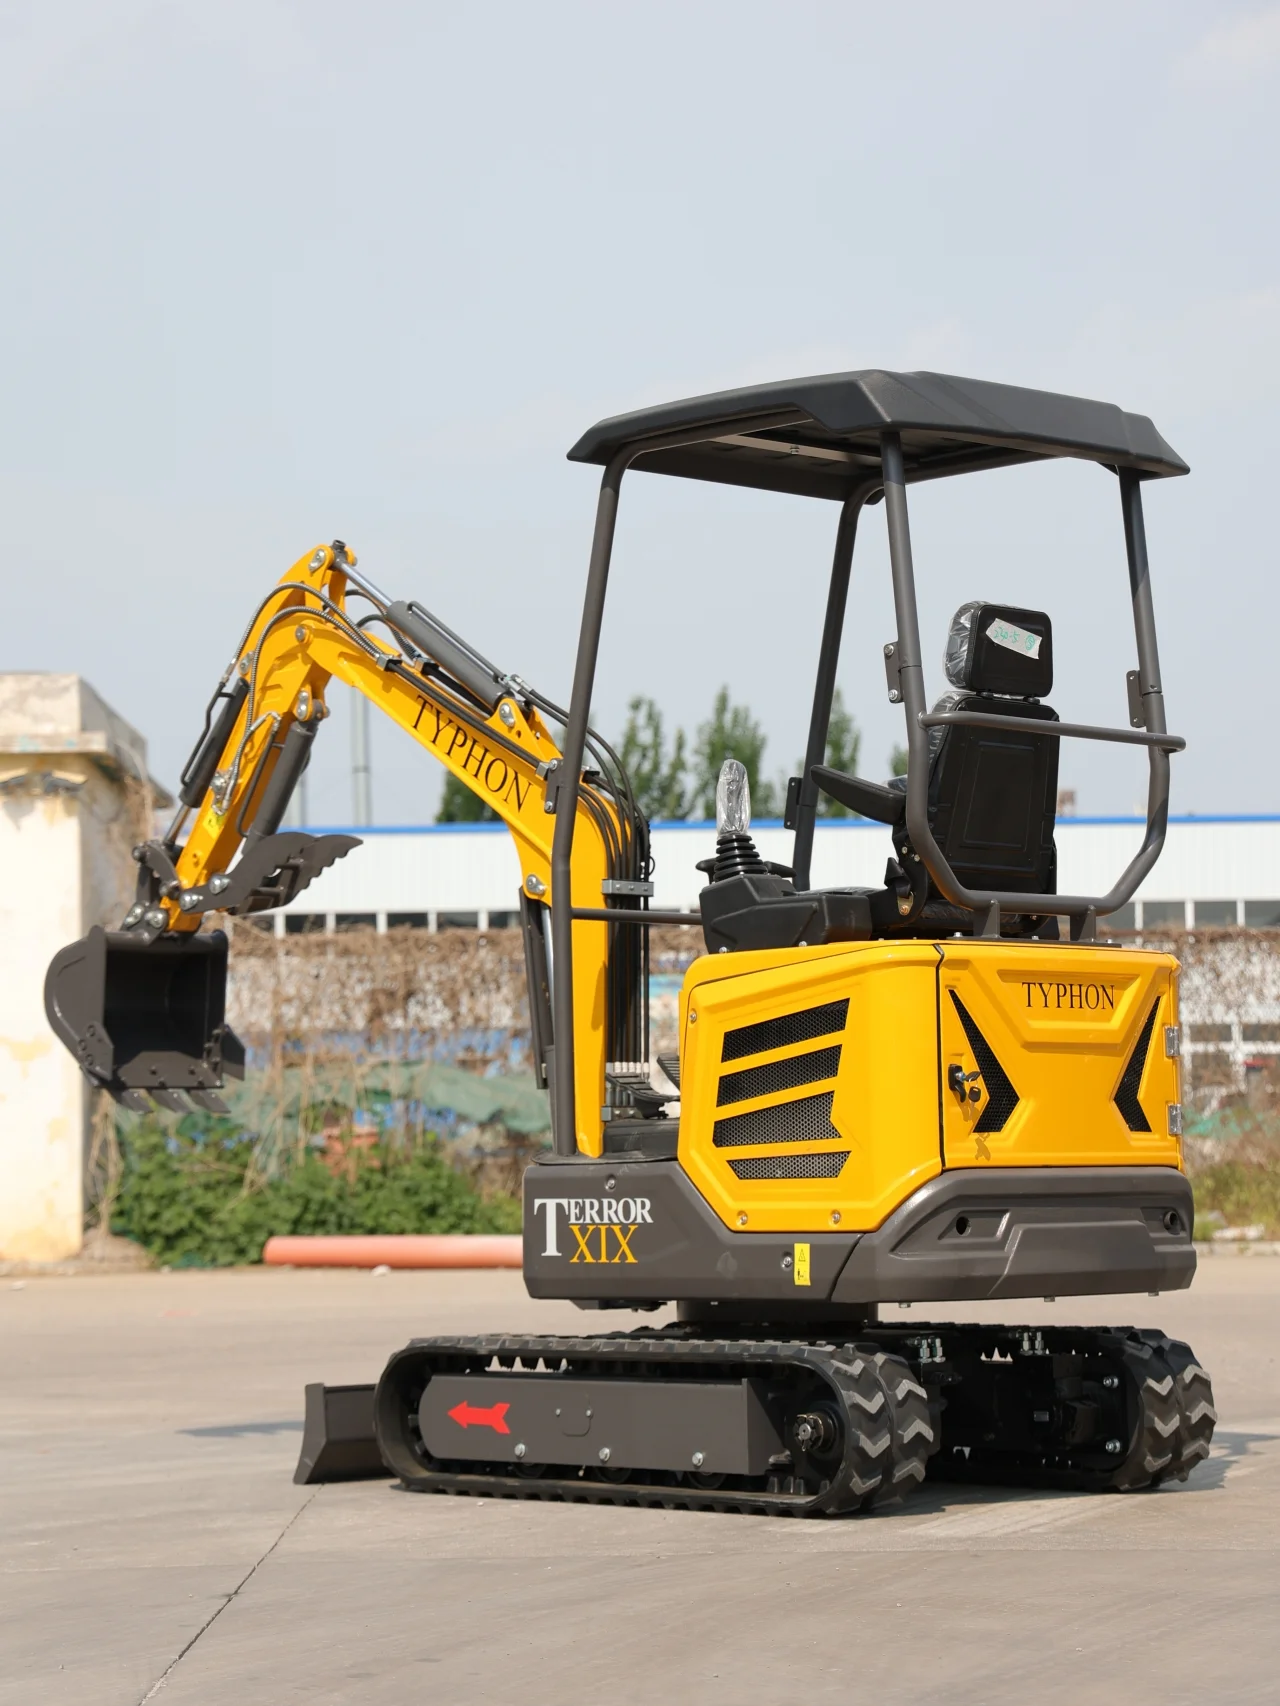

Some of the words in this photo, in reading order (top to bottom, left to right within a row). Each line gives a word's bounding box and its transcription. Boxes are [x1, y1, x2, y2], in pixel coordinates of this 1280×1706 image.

[411, 694, 533, 812] TYPHON
[1021, 981, 1115, 1010] TYPHON
[533, 1197, 654, 1257] TERROR
[569, 1225, 639, 1263] XIX
